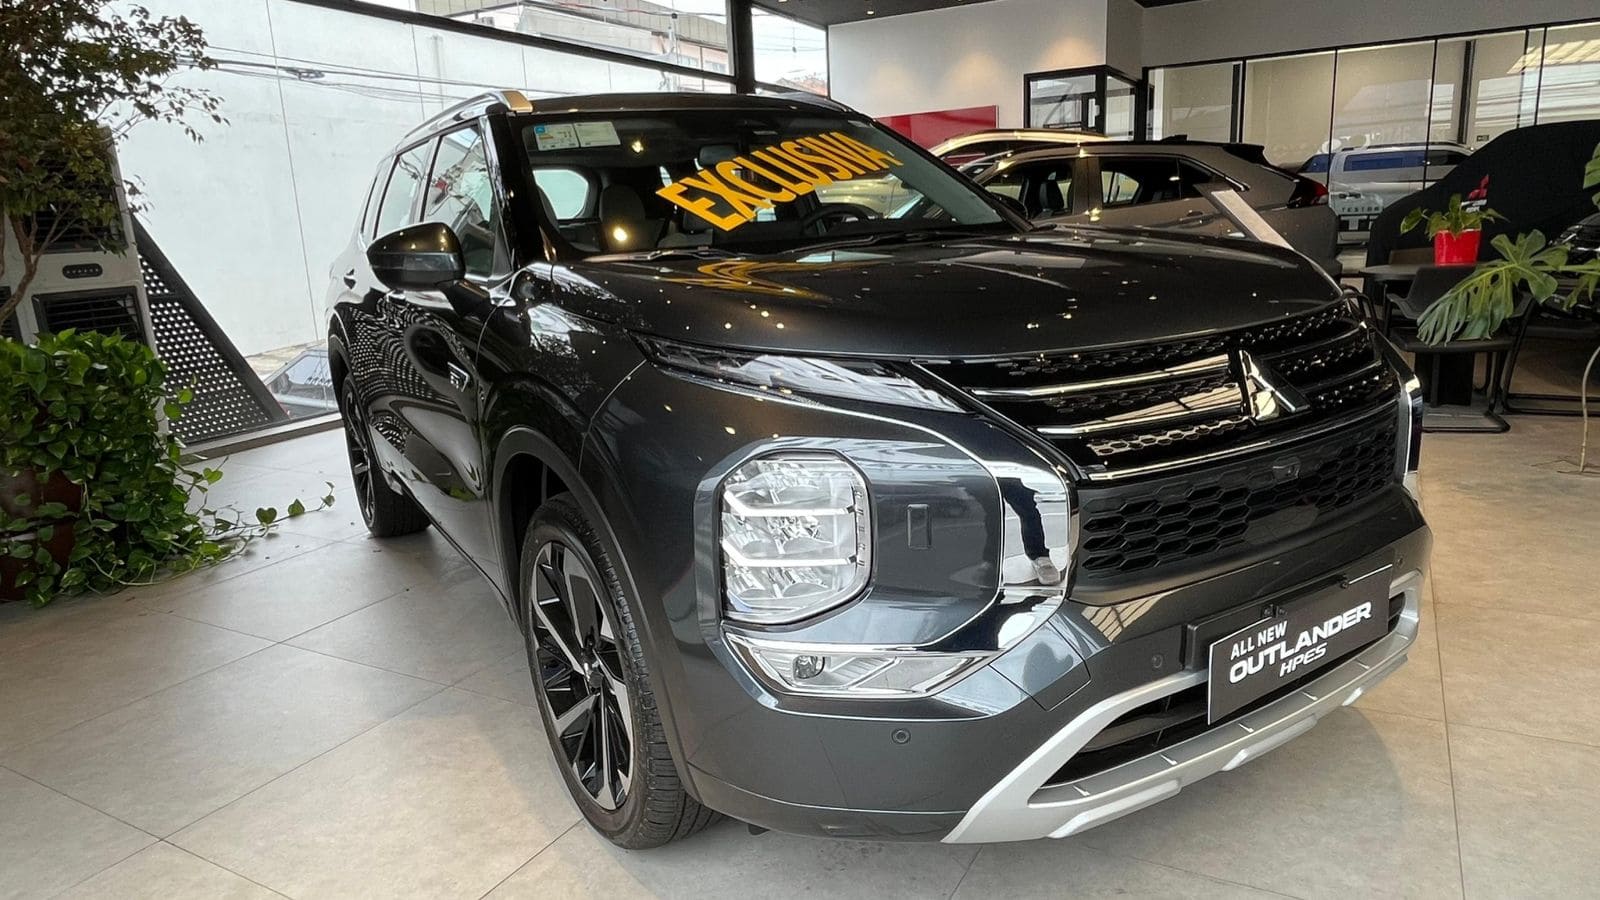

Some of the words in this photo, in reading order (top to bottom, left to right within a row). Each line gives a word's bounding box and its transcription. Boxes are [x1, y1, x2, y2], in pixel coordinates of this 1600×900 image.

[656, 132, 904, 231] EXCLUSIVA
[1229, 601, 1372, 684] OUTLANDER
[1230, 636, 1256, 661] ALL
[1257, 620, 1288, 648] NEW
[1279, 642, 1328, 677] HPES
